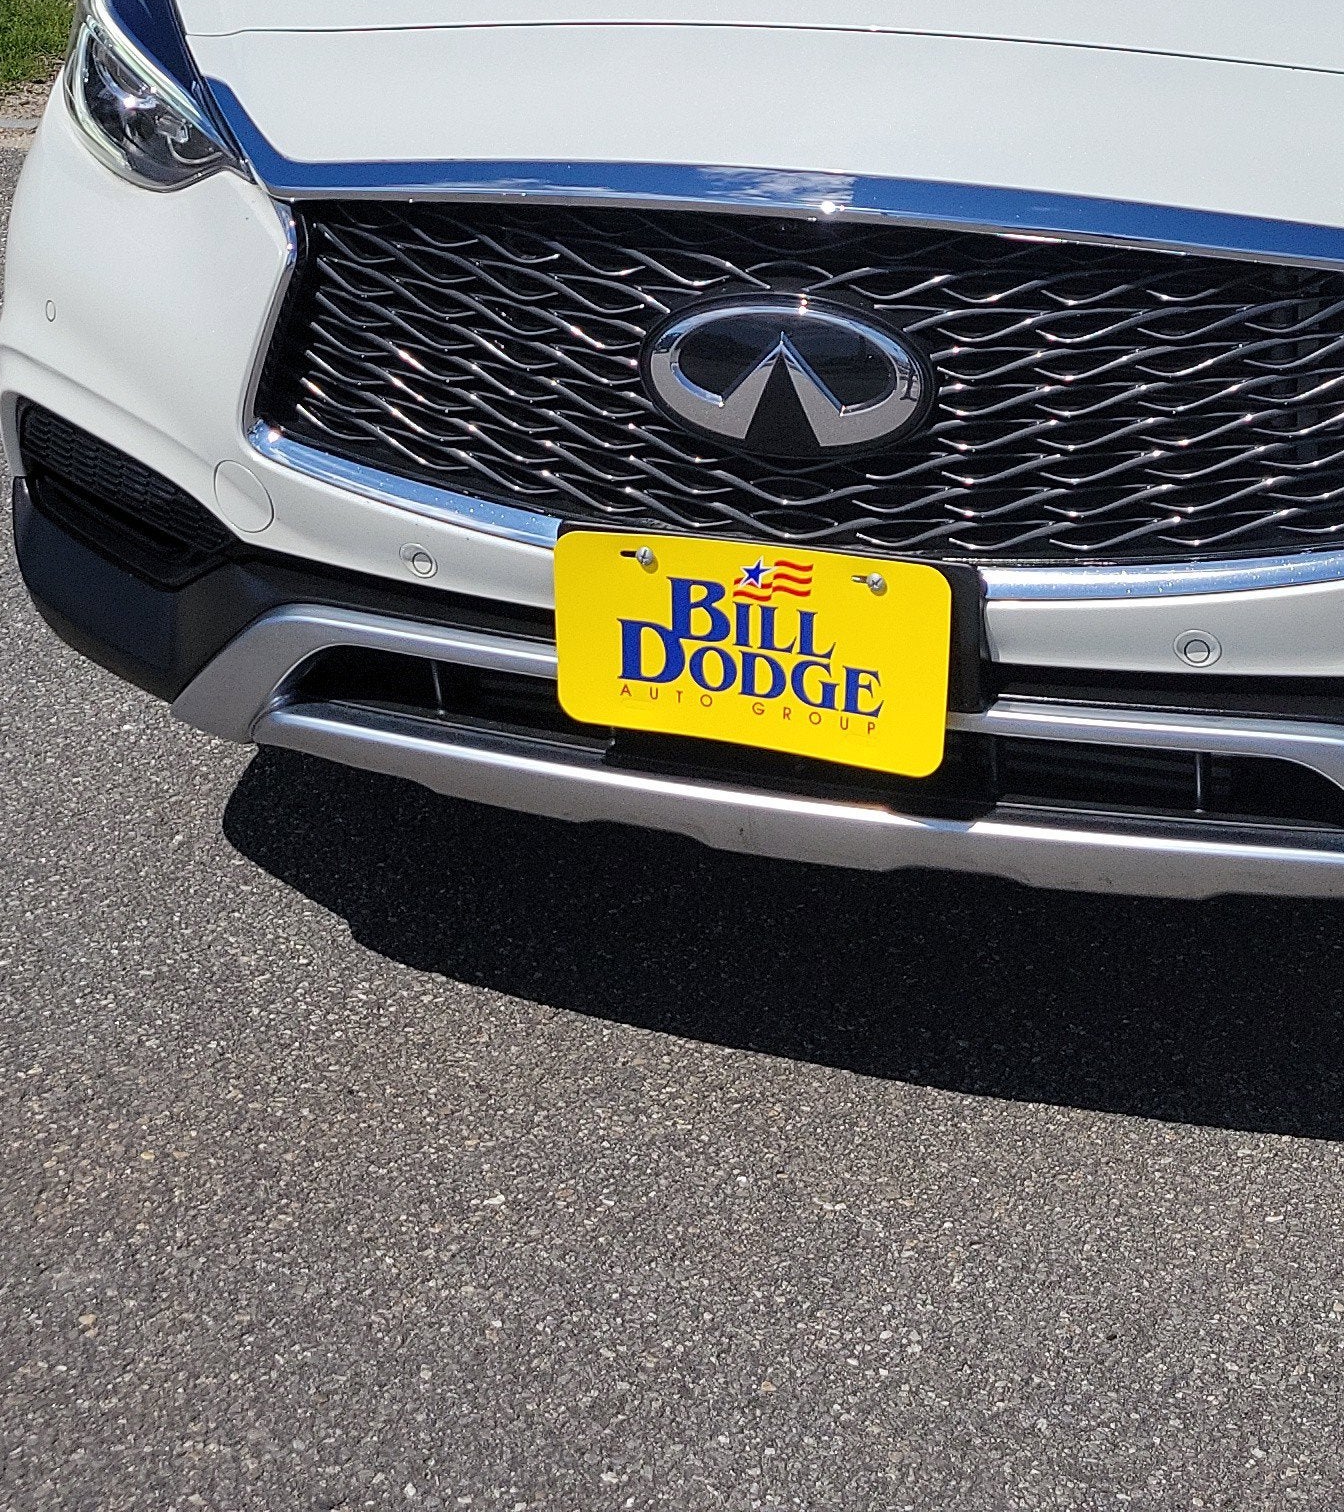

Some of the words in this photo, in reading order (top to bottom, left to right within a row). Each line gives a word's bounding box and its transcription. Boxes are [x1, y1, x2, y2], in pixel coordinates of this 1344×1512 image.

[667, 576, 836, 660] BILL
[617, 618, 885, 718] DODGE
[620, 684, 714, 708] AUTO
[752, 701, 877, 735] GROUP
